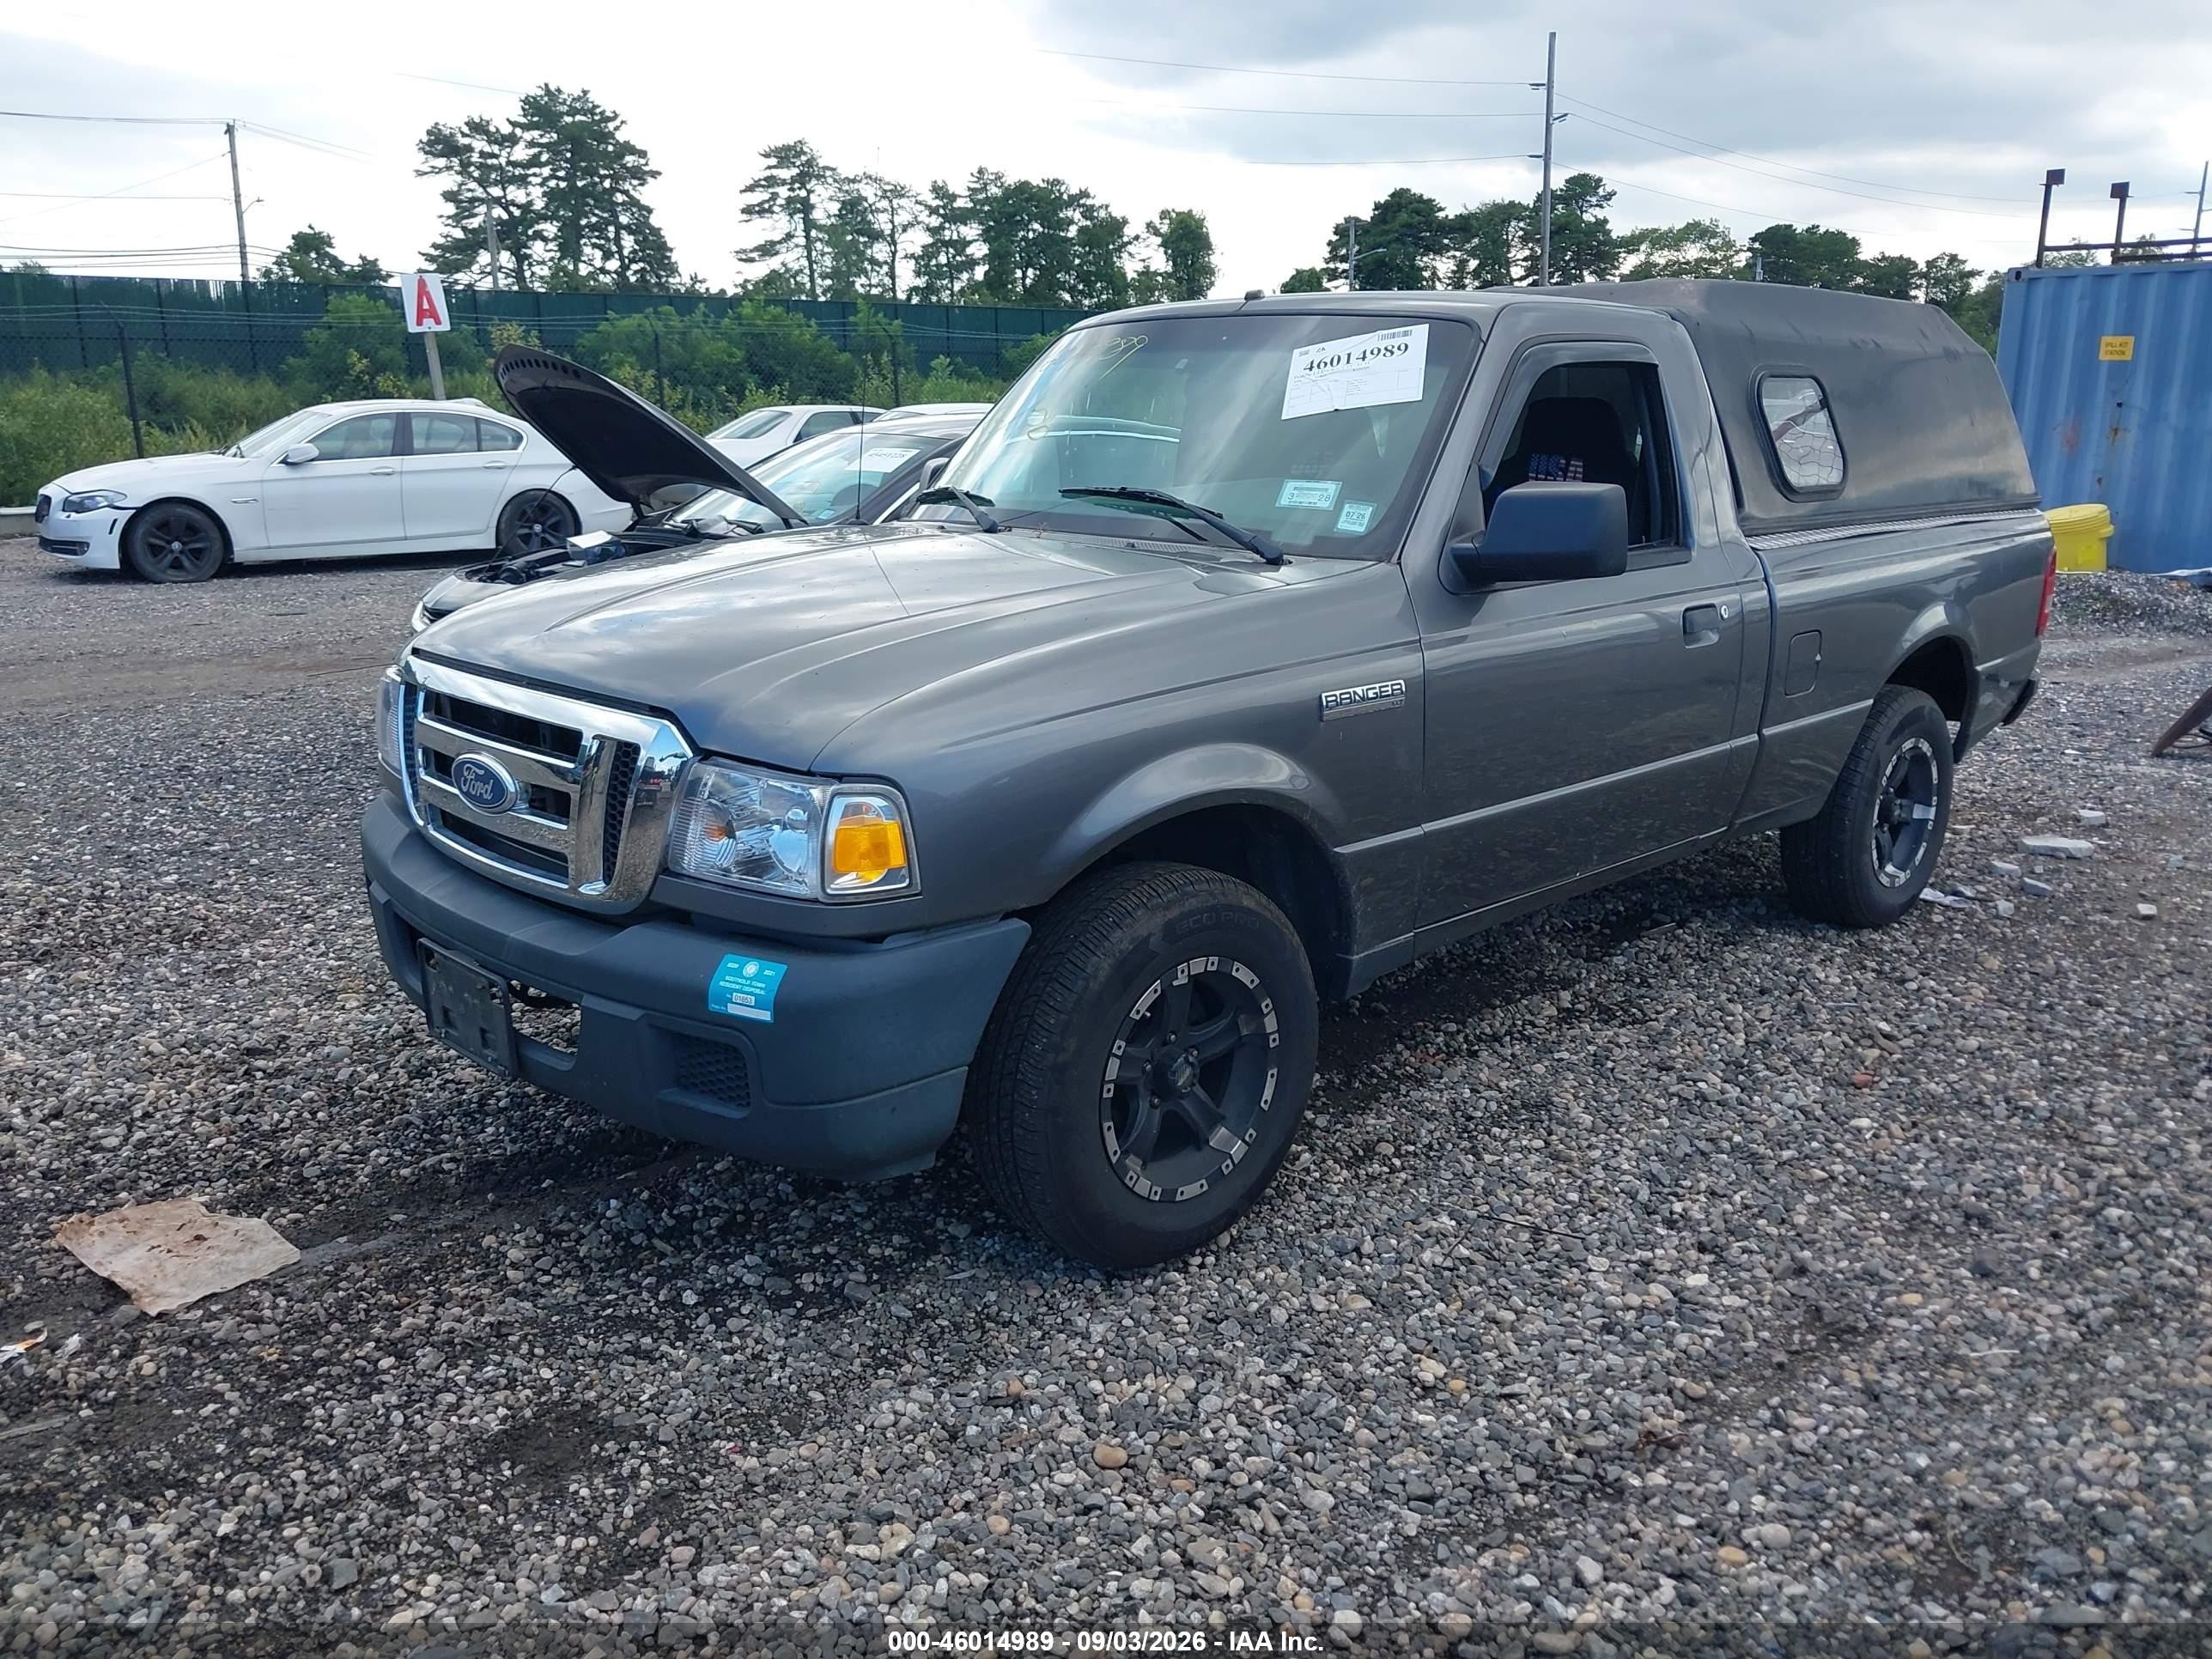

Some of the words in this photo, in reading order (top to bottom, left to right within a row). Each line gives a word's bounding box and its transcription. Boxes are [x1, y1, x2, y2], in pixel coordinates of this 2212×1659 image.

[416, 277, 442, 326] A
[1303, 342, 1409, 372] 46014989
[1287, 492, 1295, 501] 3
[1317, 494, 1331, 502] 28
[1324, 682, 1405, 709] RANGER
[460, 763, 494, 800] Ford
